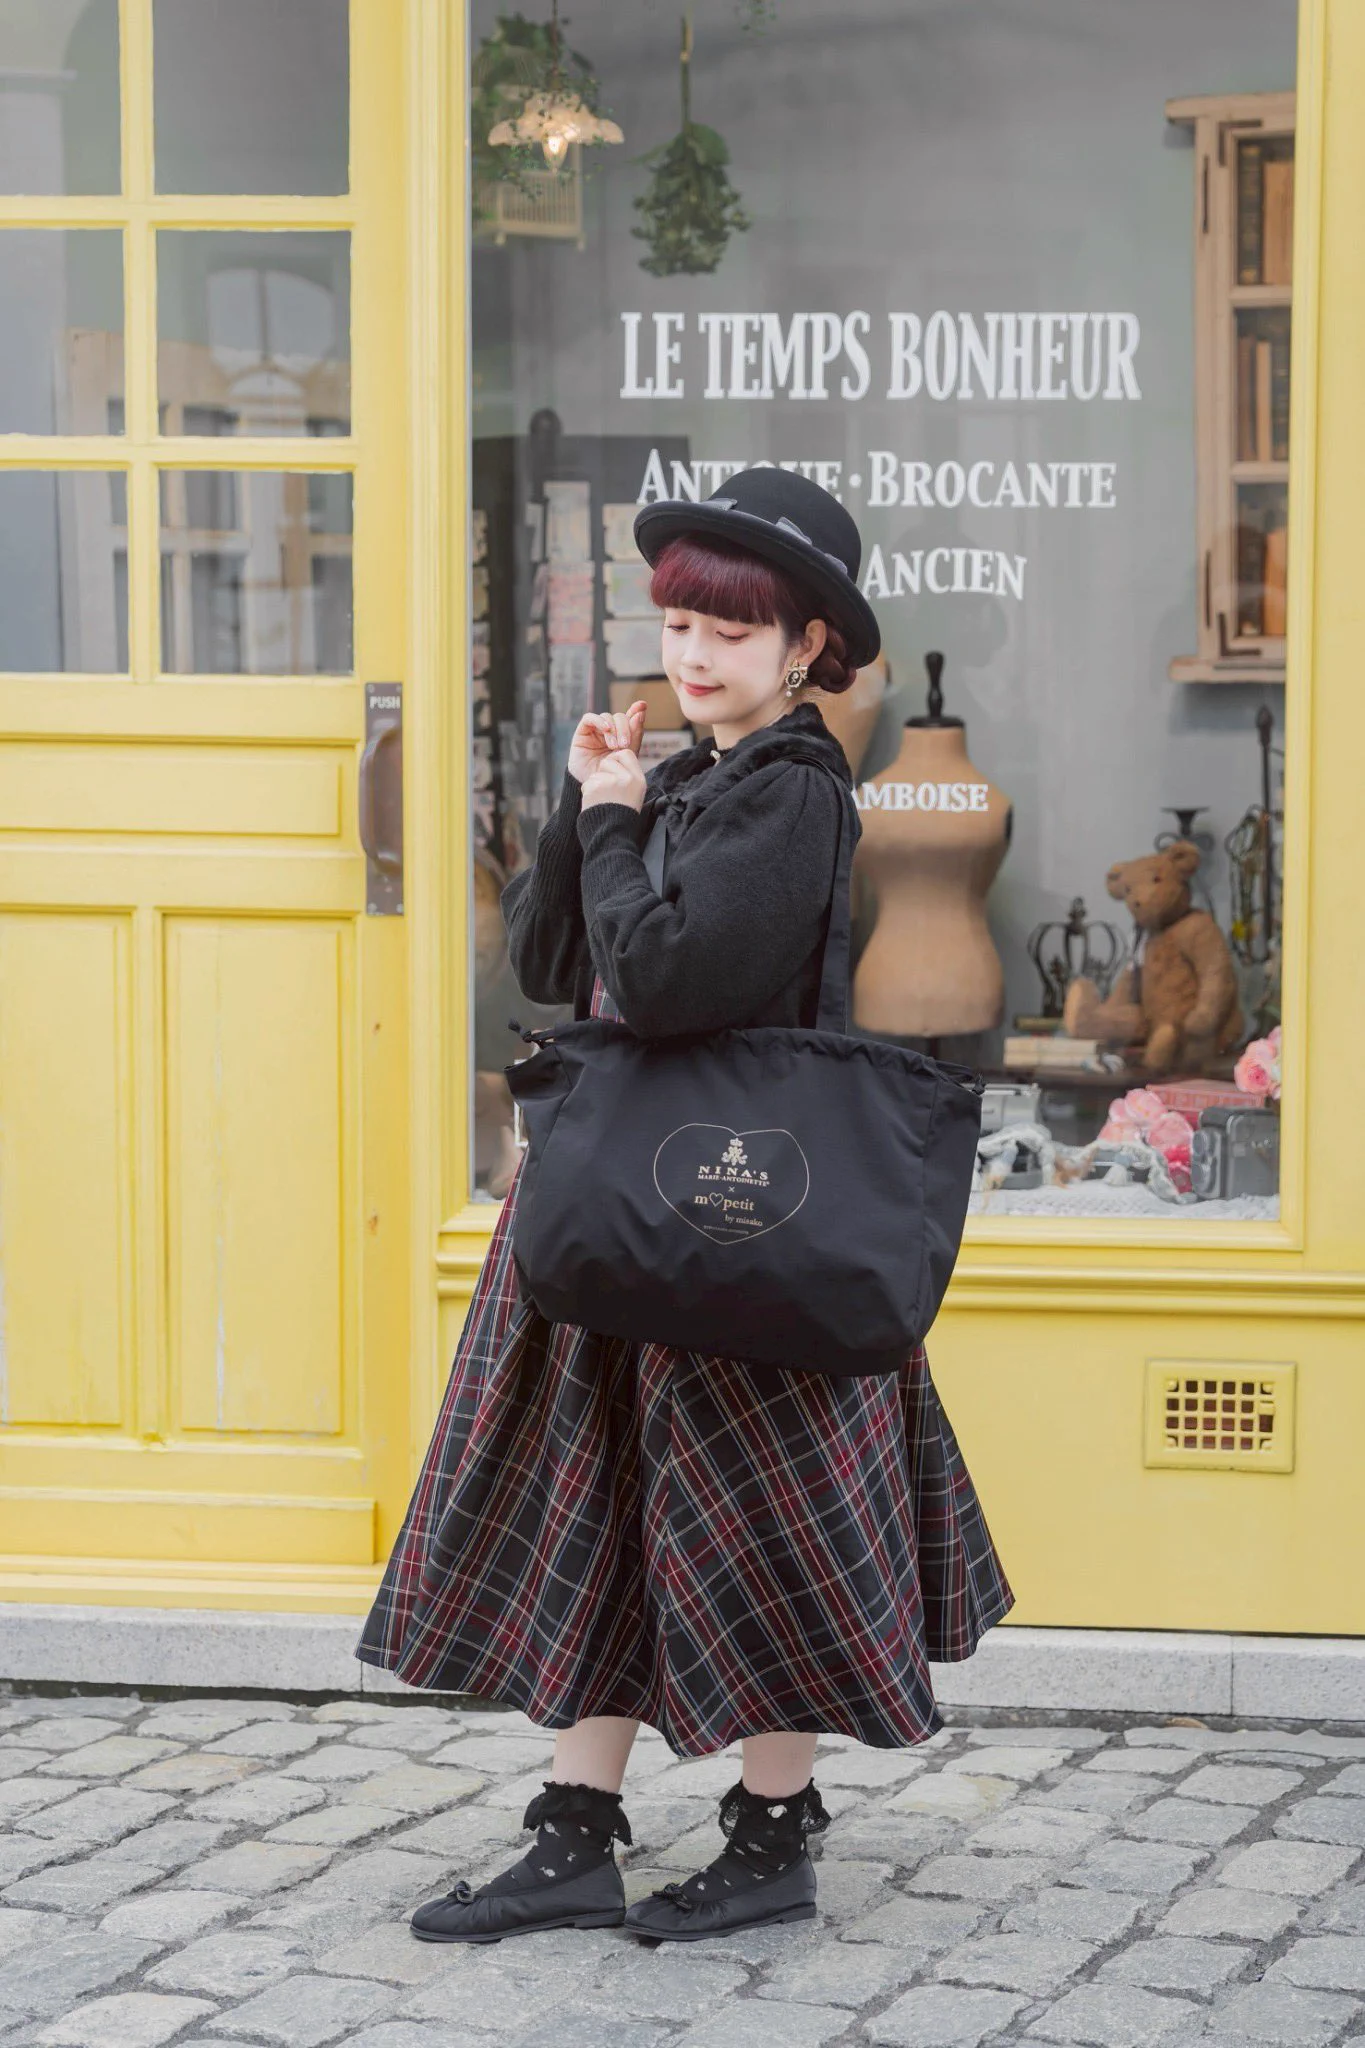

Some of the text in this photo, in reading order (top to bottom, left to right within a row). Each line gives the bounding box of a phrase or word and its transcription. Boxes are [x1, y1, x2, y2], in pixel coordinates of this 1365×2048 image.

[620, 310, 1142, 401] LE TEMPS BONHEUR
[636, 448, 1117, 507] ANTE BROCANTE
[863, 544, 1028, 600] ANCIEN
[369, 695, 401, 709] PUSH
[698, 1165, 769, 1181] NINA'S
[725, 1214, 763, 1227] by misako
